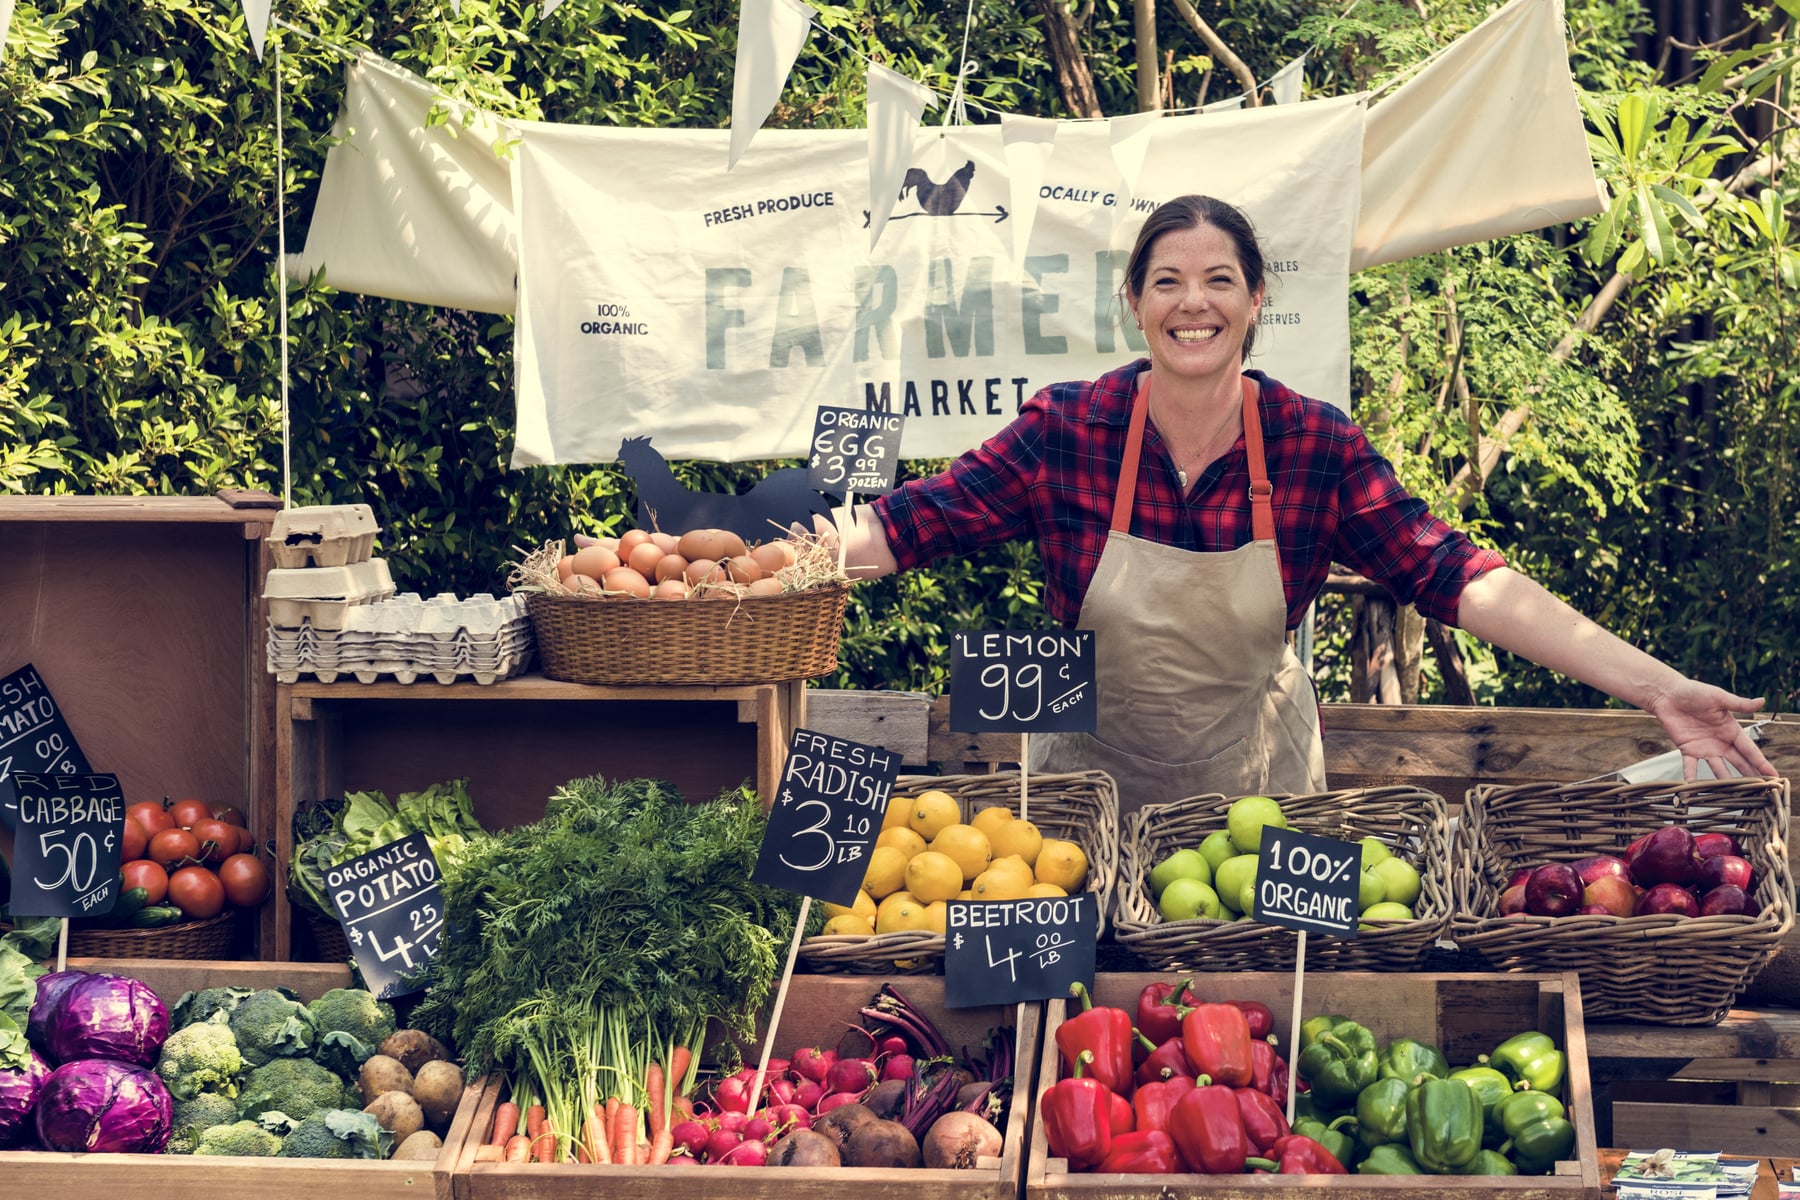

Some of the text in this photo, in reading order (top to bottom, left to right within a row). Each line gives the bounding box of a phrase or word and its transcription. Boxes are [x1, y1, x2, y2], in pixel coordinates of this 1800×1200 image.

[704, 192, 834, 227] FRESH PRODUCE
[1039, 186, 1099, 203] OCALLY
[597, 304, 631, 318] 100%
[704, 250, 1149, 370] FARMER
[1262, 312, 1301, 325] SERVES
[580, 322, 648, 335] ORGANIC
[865, 377, 1029, 417] MARKET
[820, 411, 899, 431] ORGANIC
[814, 429, 885, 458] EGG
[847, 477, 888, 490] DOZEN
[978, 663, 1042, 721] 99
[1052, 690, 1083, 714] EACH
[0, 696, 54, 740] MATO
[794, 732, 889, 772] FRESH
[14, 774, 117, 792] RED
[786, 754, 891, 814] RADISH
[20, 795, 122, 825] CABBAGE
[34, 829, 97, 893] 50
[327, 842, 418, 887] ORGANIC
[837, 845, 862, 864] LB
[1269, 839, 1354, 884] 100%
[83, 886, 109, 912] EACH
[335, 858, 435, 918] POTATO
[1261, 879, 1352, 922] ORGANIC
[949, 897, 1084, 928] BEETROOT
[1039, 950, 1061, 969] LB
